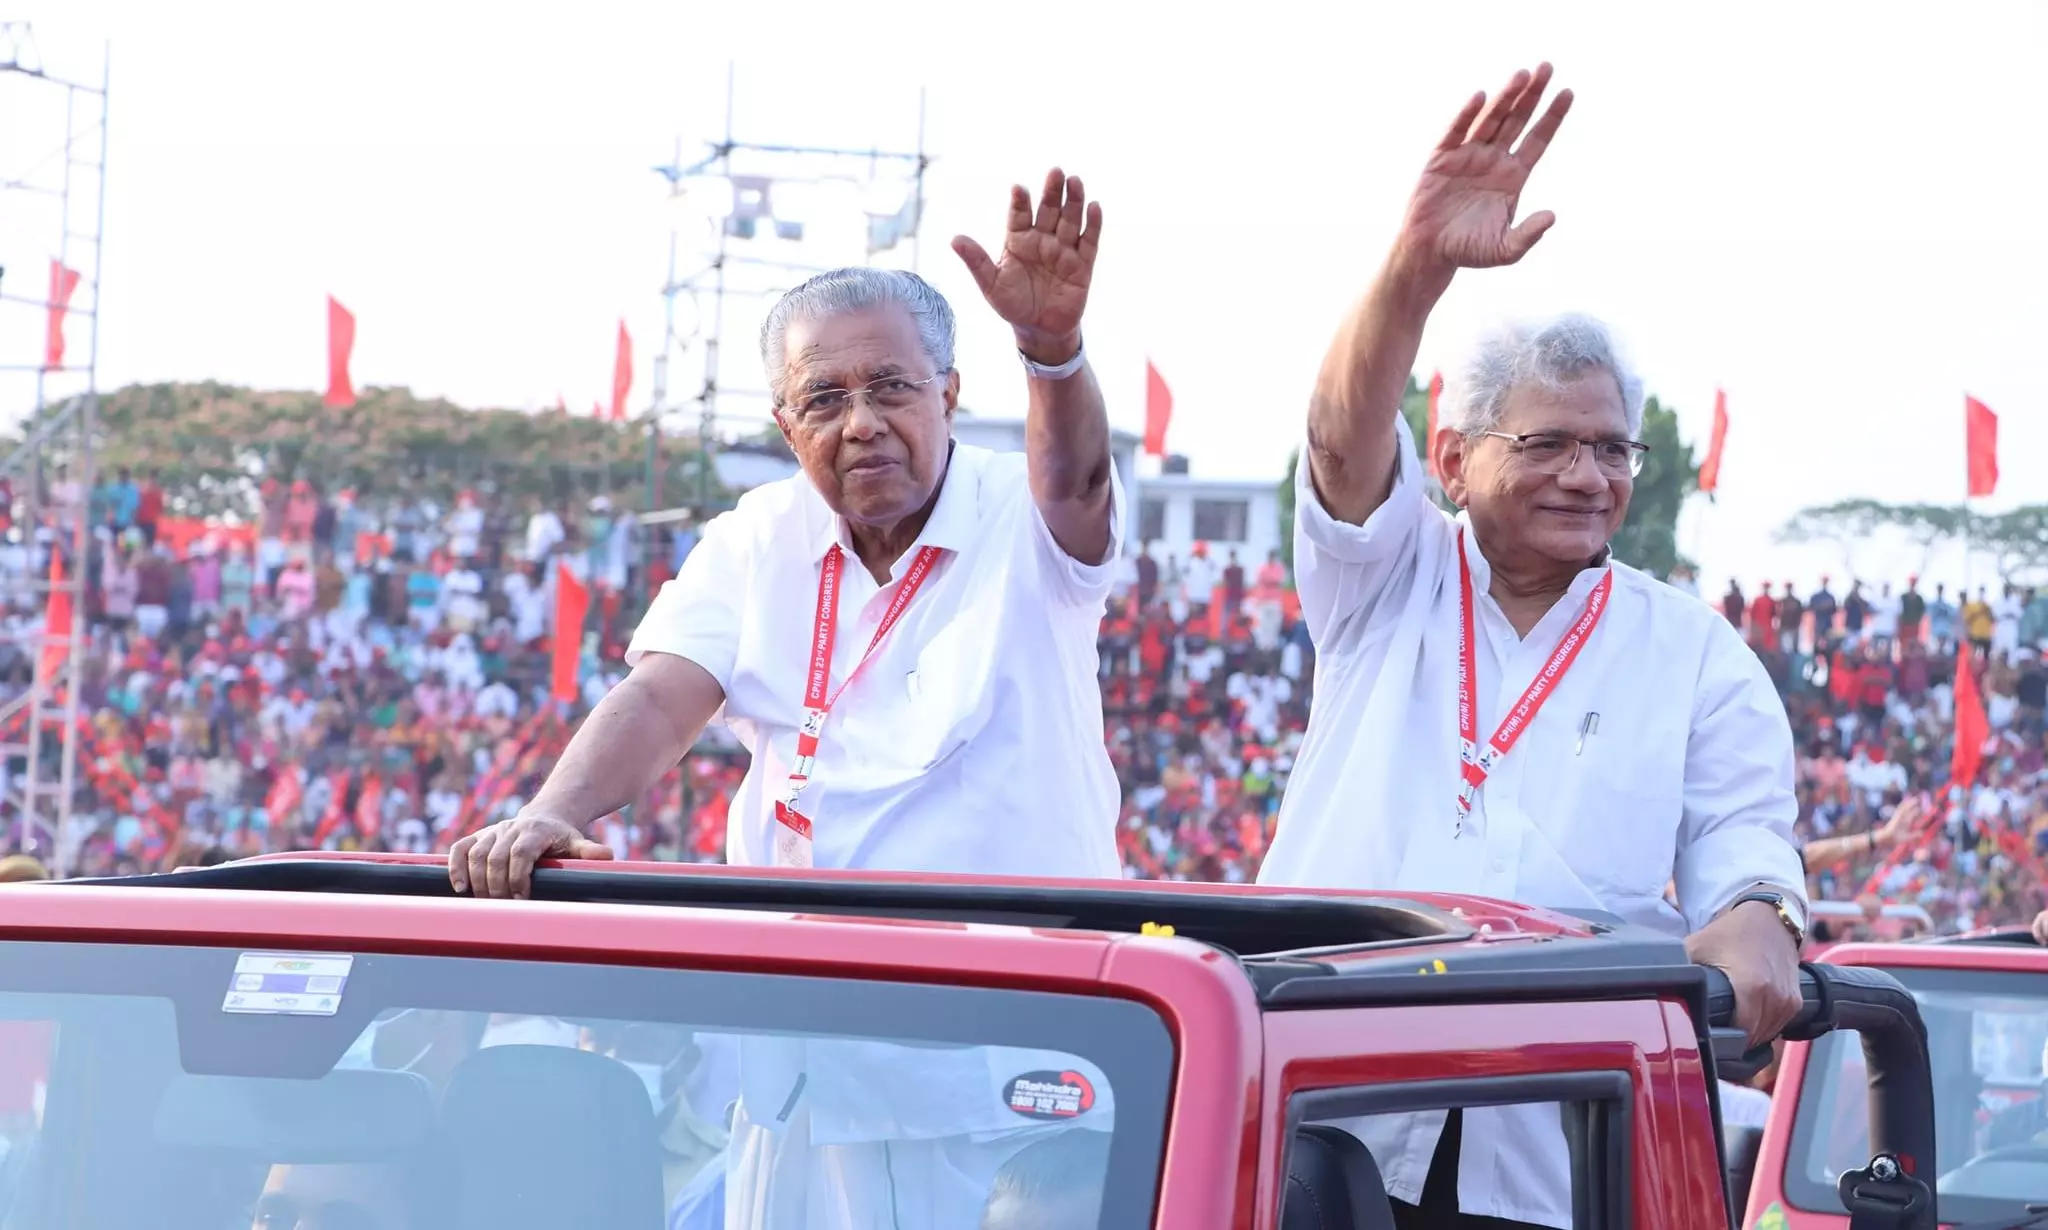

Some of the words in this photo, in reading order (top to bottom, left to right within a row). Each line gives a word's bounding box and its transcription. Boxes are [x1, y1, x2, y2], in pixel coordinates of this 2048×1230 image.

[821, 572, 834, 619] CONGRESS
[881, 585, 913, 632] CONGRESS
[909, 561, 925, 585] 2022
[817, 621, 829, 651] PARTY
[811, 669, 825, 699] CPI(M)
[1498, 715, 1522, 742] CPI(M)
[1527, 676, 1549, 702] PARTY
[1545, 633, 1579, 677] CONGRESS
[1576, 612, 1595, 635] 2022
[1591, 591, 1604, 615] APRIL
